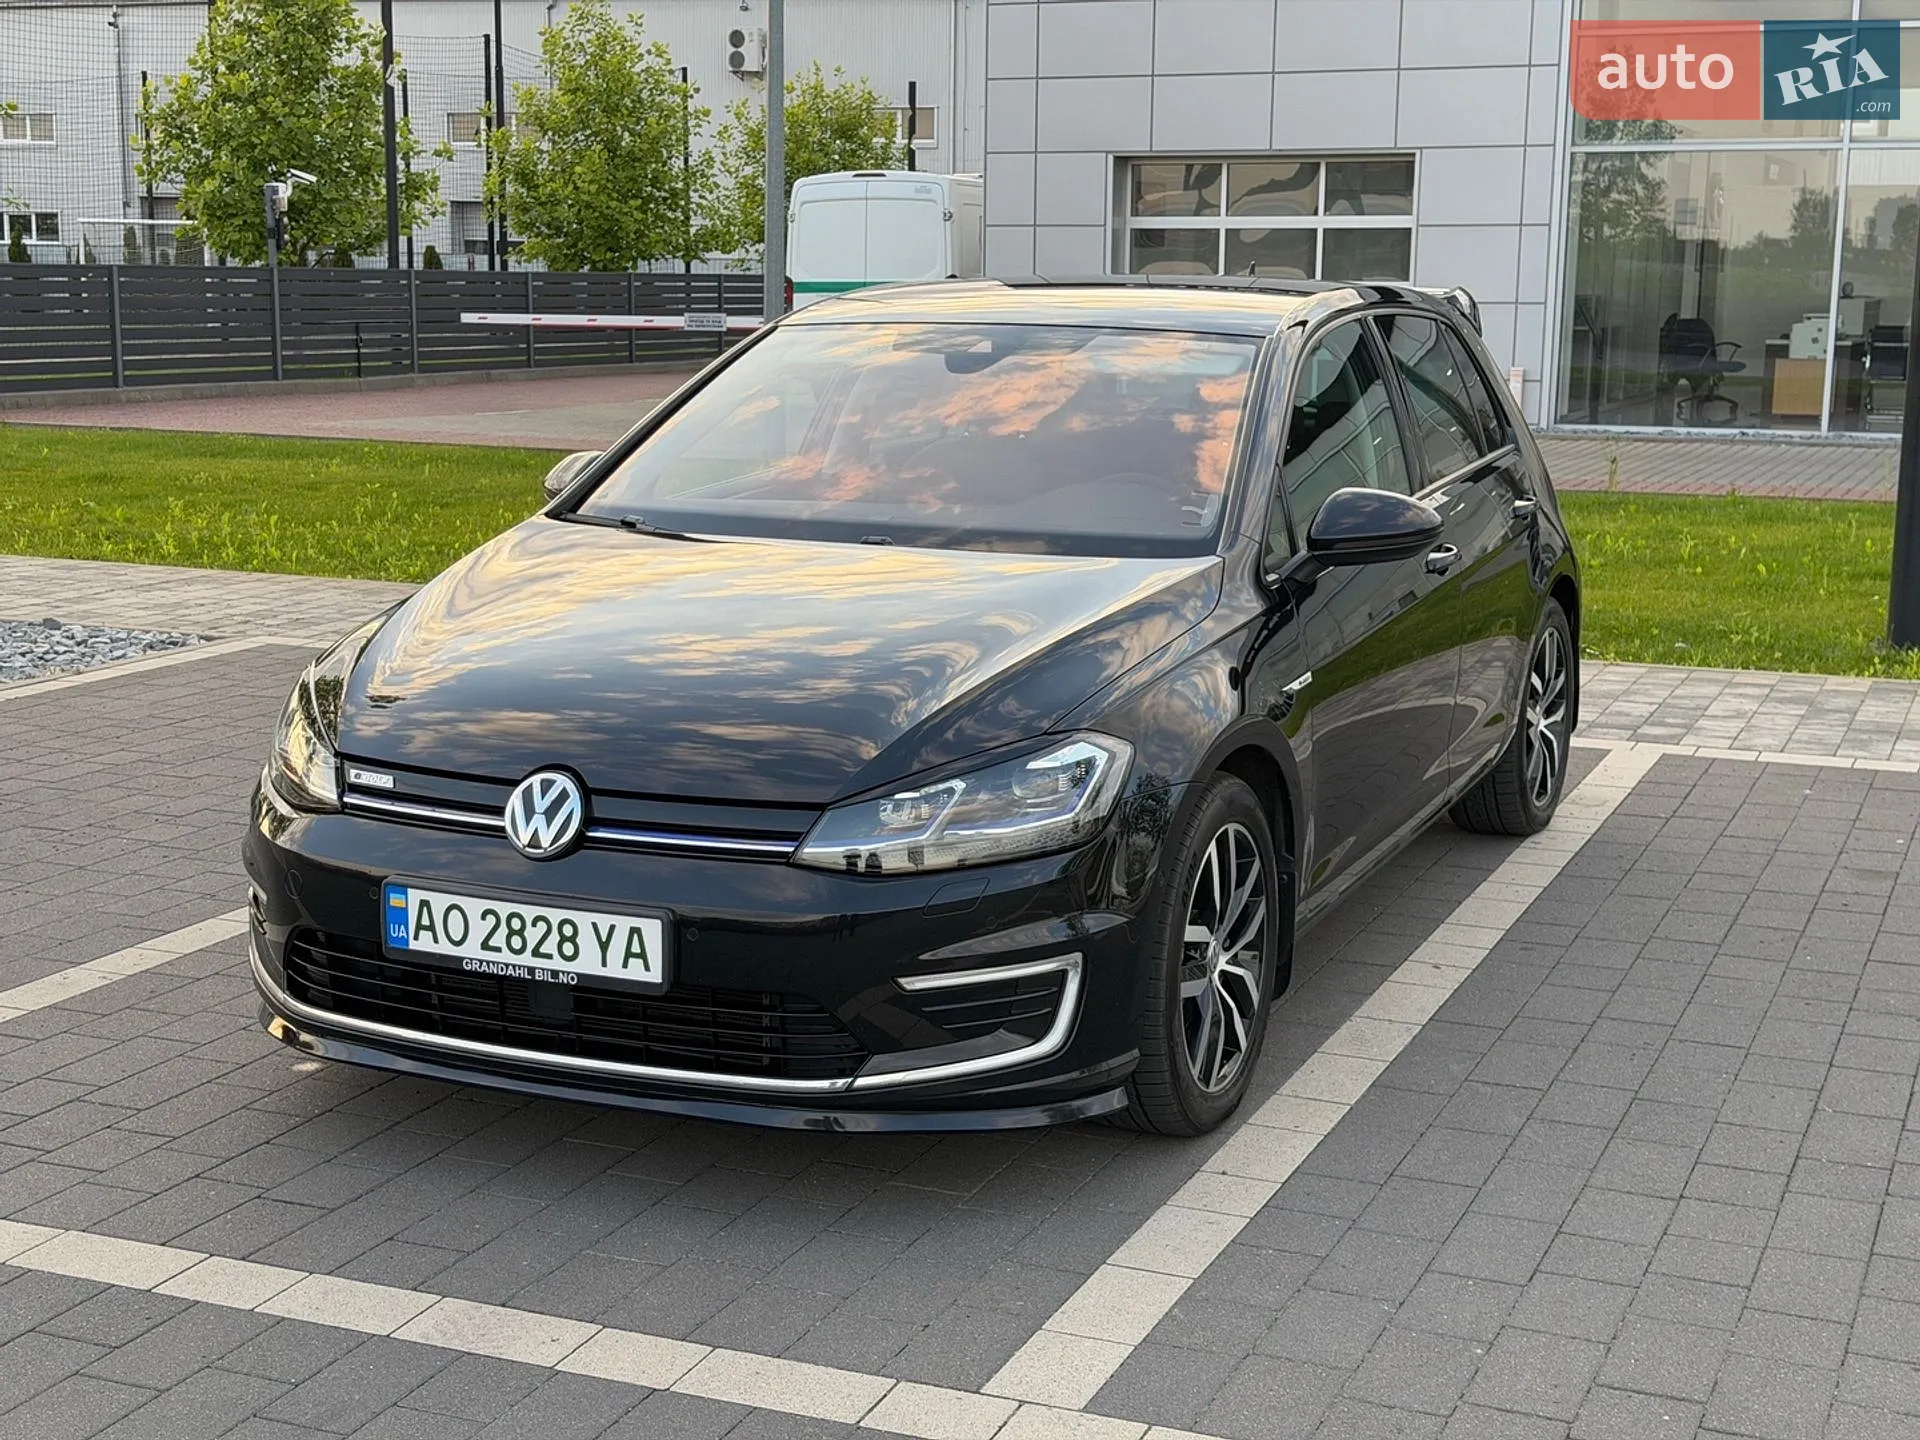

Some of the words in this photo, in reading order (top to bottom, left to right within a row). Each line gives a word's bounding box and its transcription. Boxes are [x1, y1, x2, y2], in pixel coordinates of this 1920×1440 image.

[505, 773, 581, 852] VW
[390, 923, 408, 939] UA
[413, 898, 470, 948] AO
[479, 907, 581, 963] 2828
[590, 920, 652, 973] YA
[462, 958, 532, 979] GRANDAHL
[534, 969, 578, 986] BIL.NO
